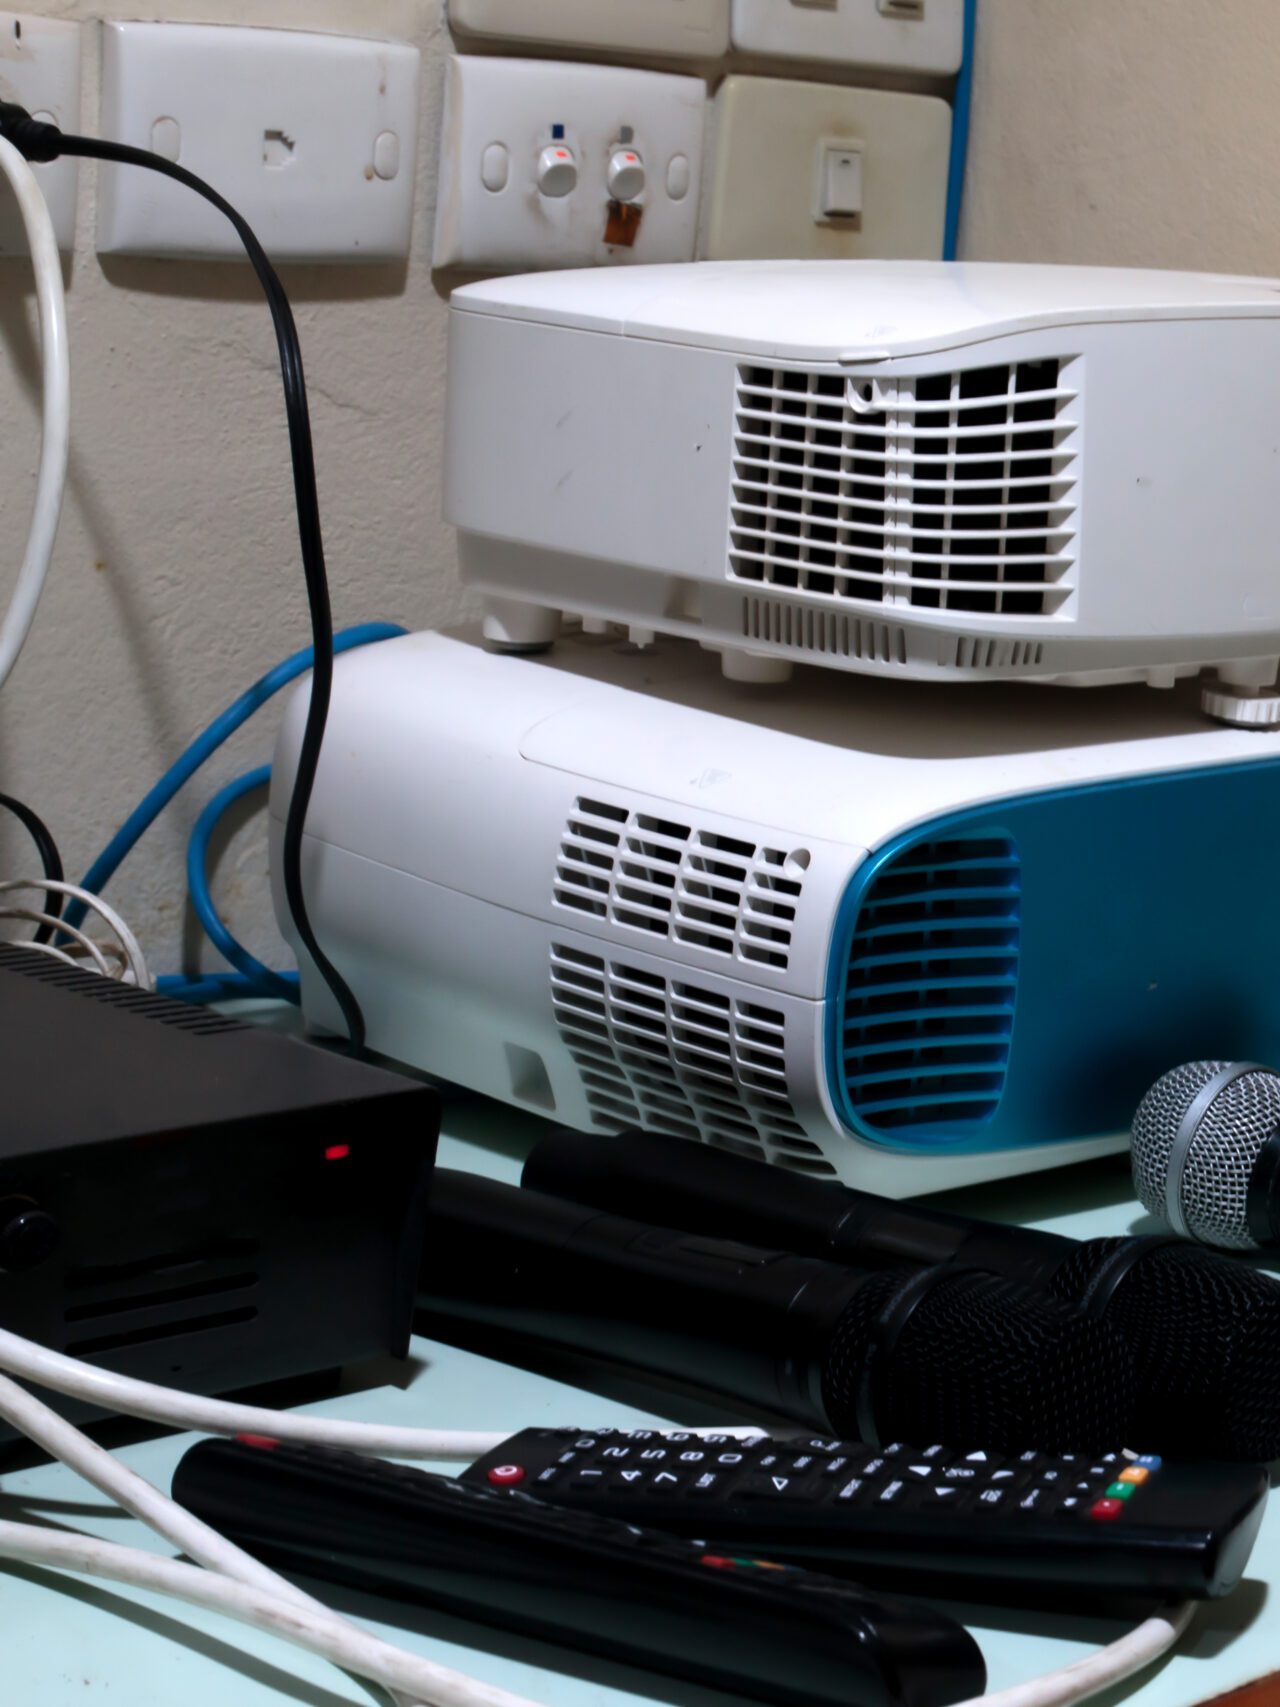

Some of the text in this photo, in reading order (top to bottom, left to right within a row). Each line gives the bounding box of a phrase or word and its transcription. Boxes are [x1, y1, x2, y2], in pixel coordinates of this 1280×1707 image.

[627, 1429, 653, 1441] 3
[665, 1431, 691, 1442] 6
[603, 1447, 630, 1457] 2
[640, 1448, 666, 1458] 5
[679, 1450, 704, 1461] 8
[717, 1452, 743, 1463] 0
[621, 1470, 642, 1481] 4
[654, 1471, 678, 1483] 7
